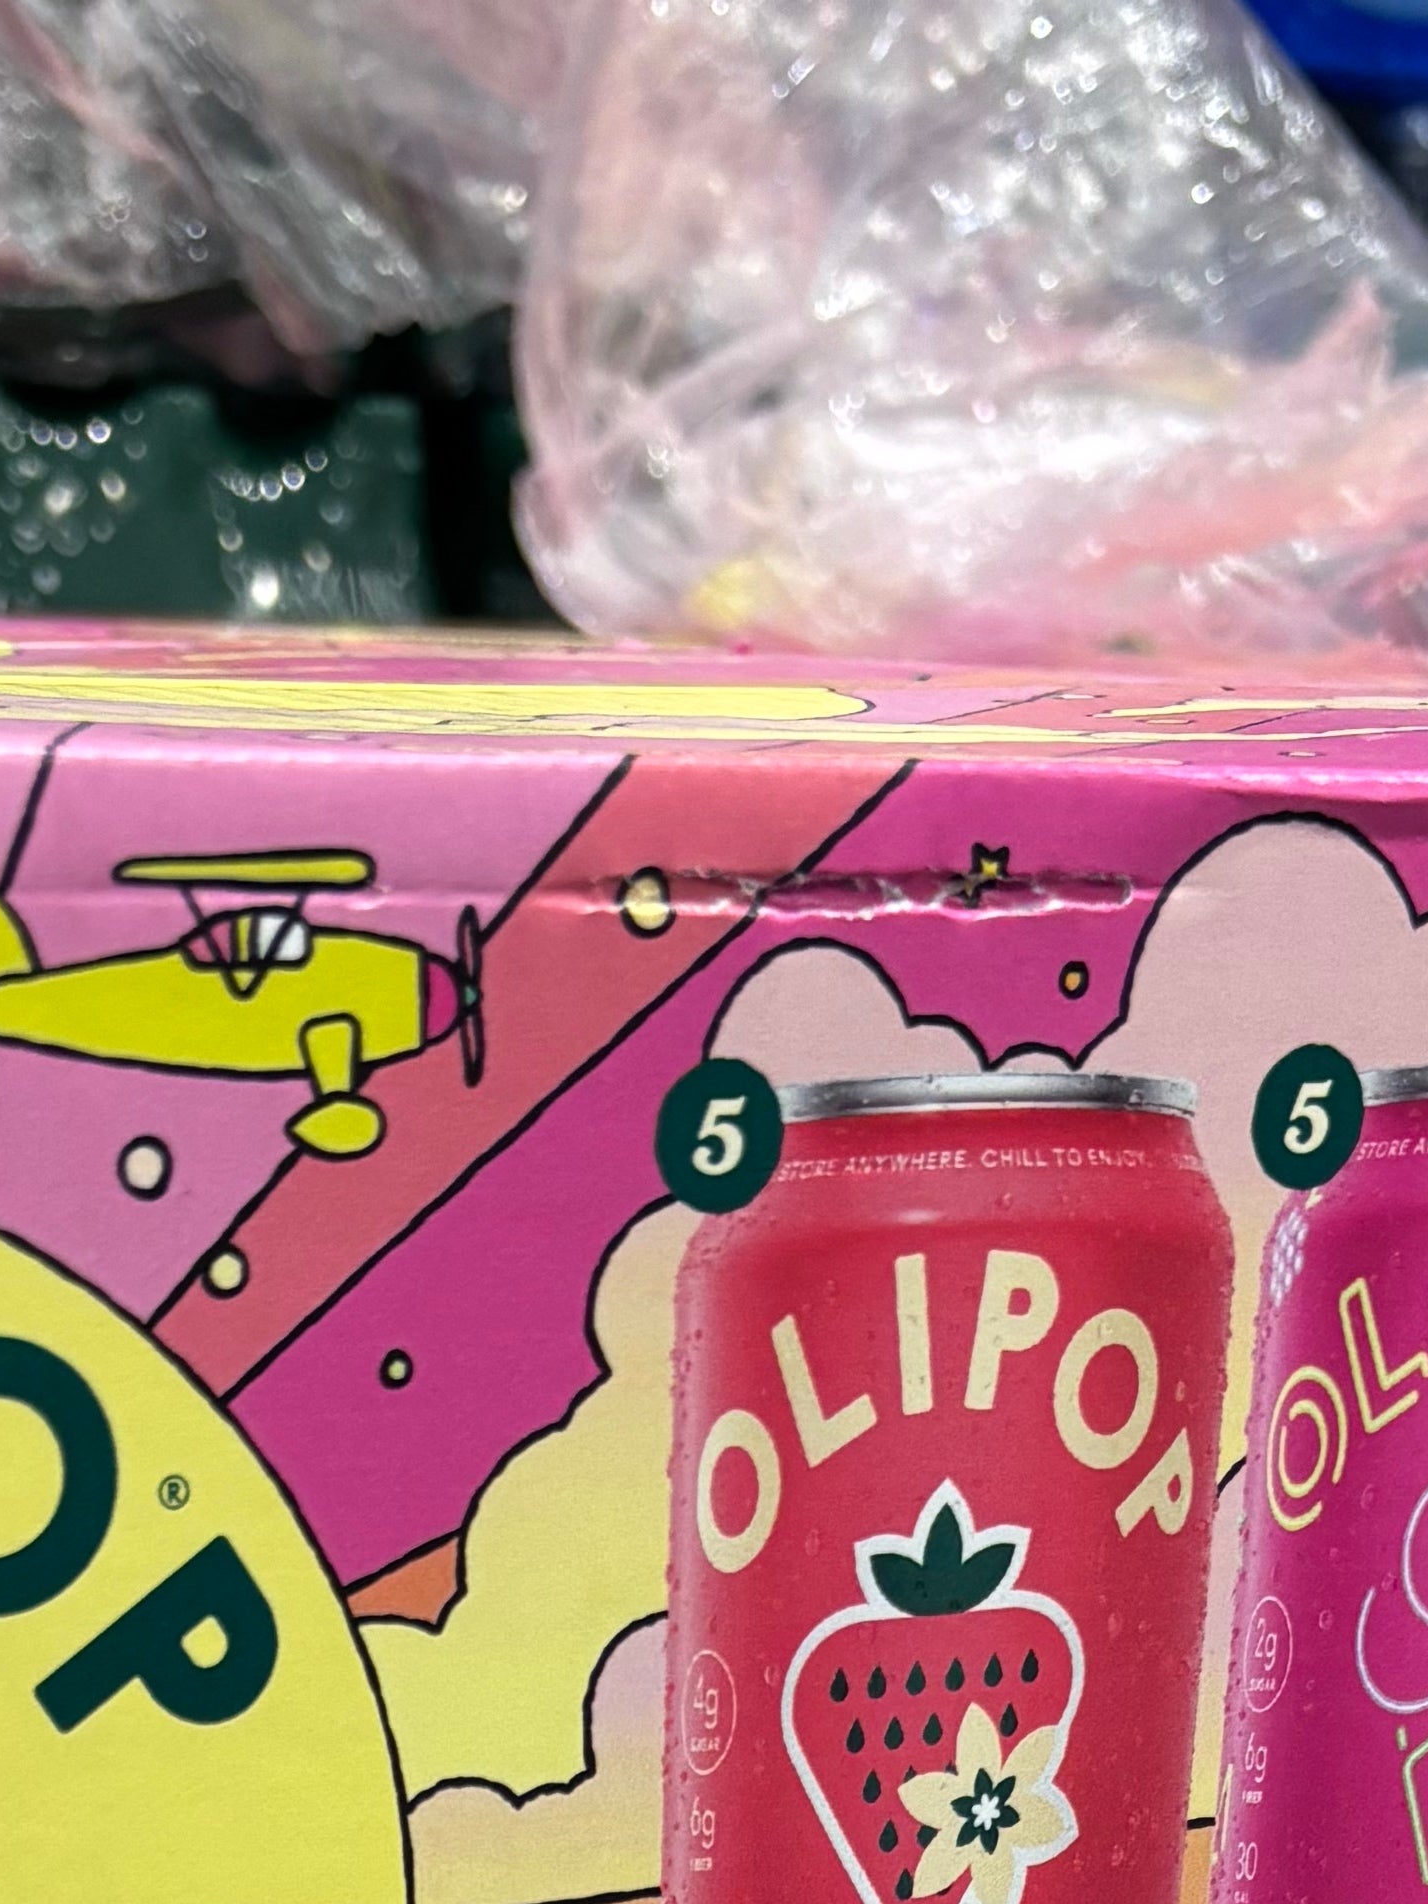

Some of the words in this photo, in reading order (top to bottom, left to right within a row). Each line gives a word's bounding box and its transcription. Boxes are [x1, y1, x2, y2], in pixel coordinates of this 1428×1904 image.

[692, 1096, 746, 1176] 5
[1283, 1079, 1332, 1154] 5
[697, 1249, 1193, 1573] OLIPOP
[690, 1796, 716, 1850] 6g
